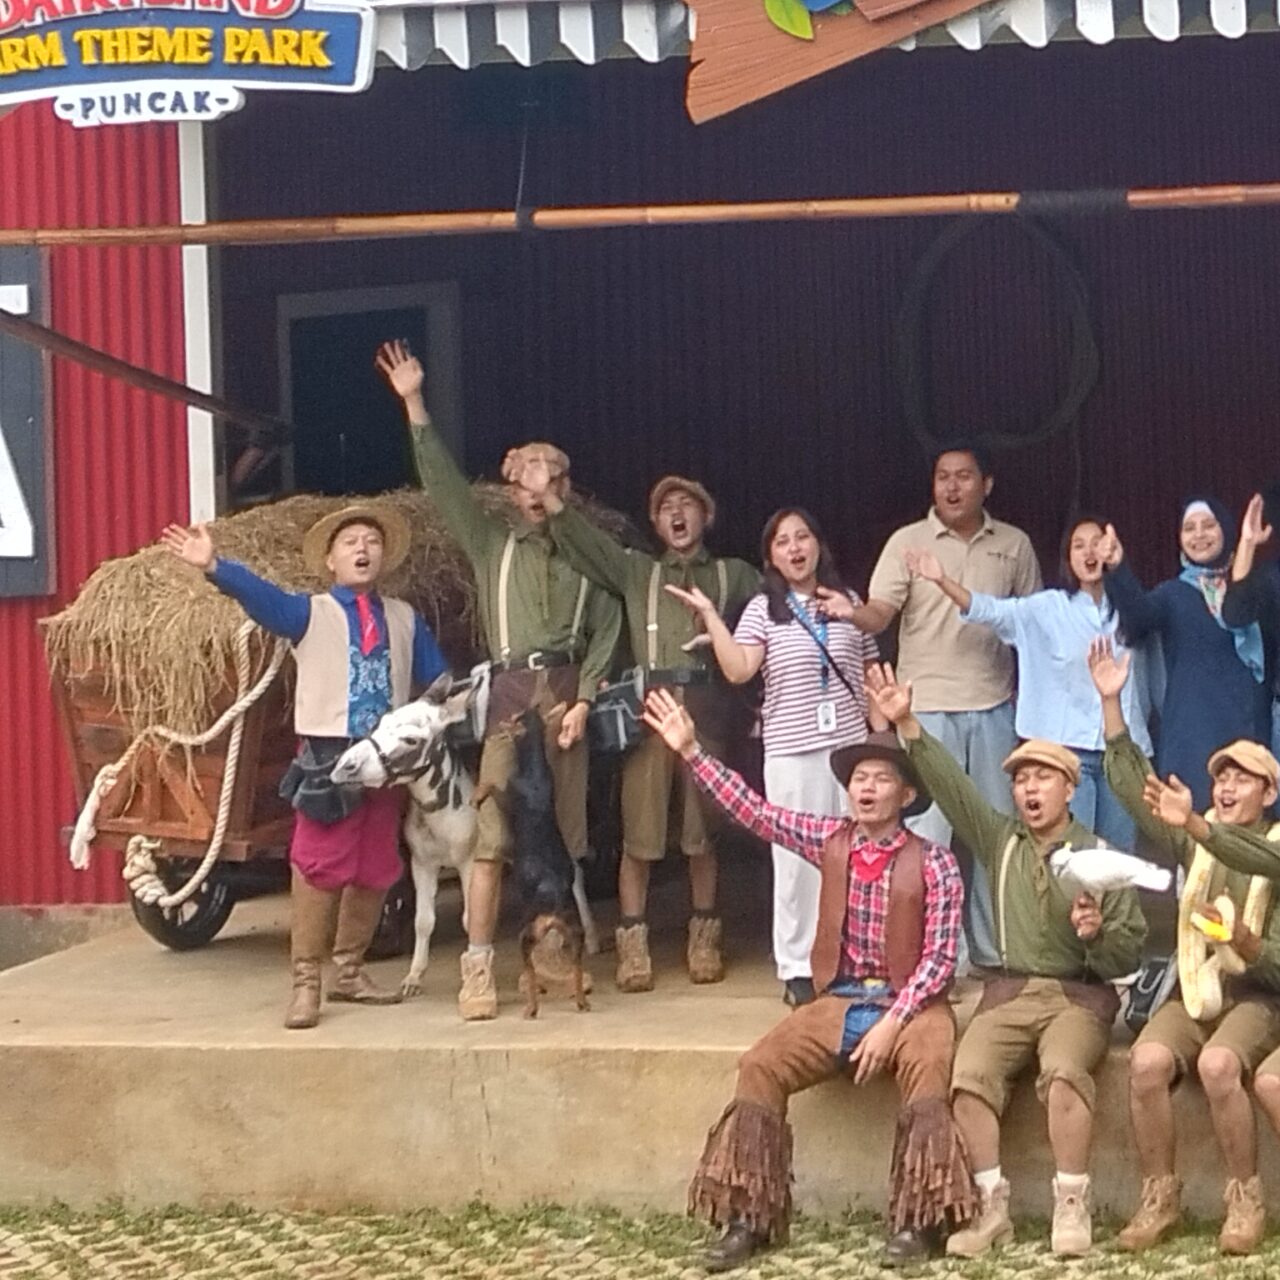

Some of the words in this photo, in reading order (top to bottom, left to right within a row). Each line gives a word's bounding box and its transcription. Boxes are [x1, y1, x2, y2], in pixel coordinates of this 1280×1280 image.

[0, 30, 67, 75] RM
[73, 26, 214, 66] THEME
[223, 28, 334, 68] PARK
